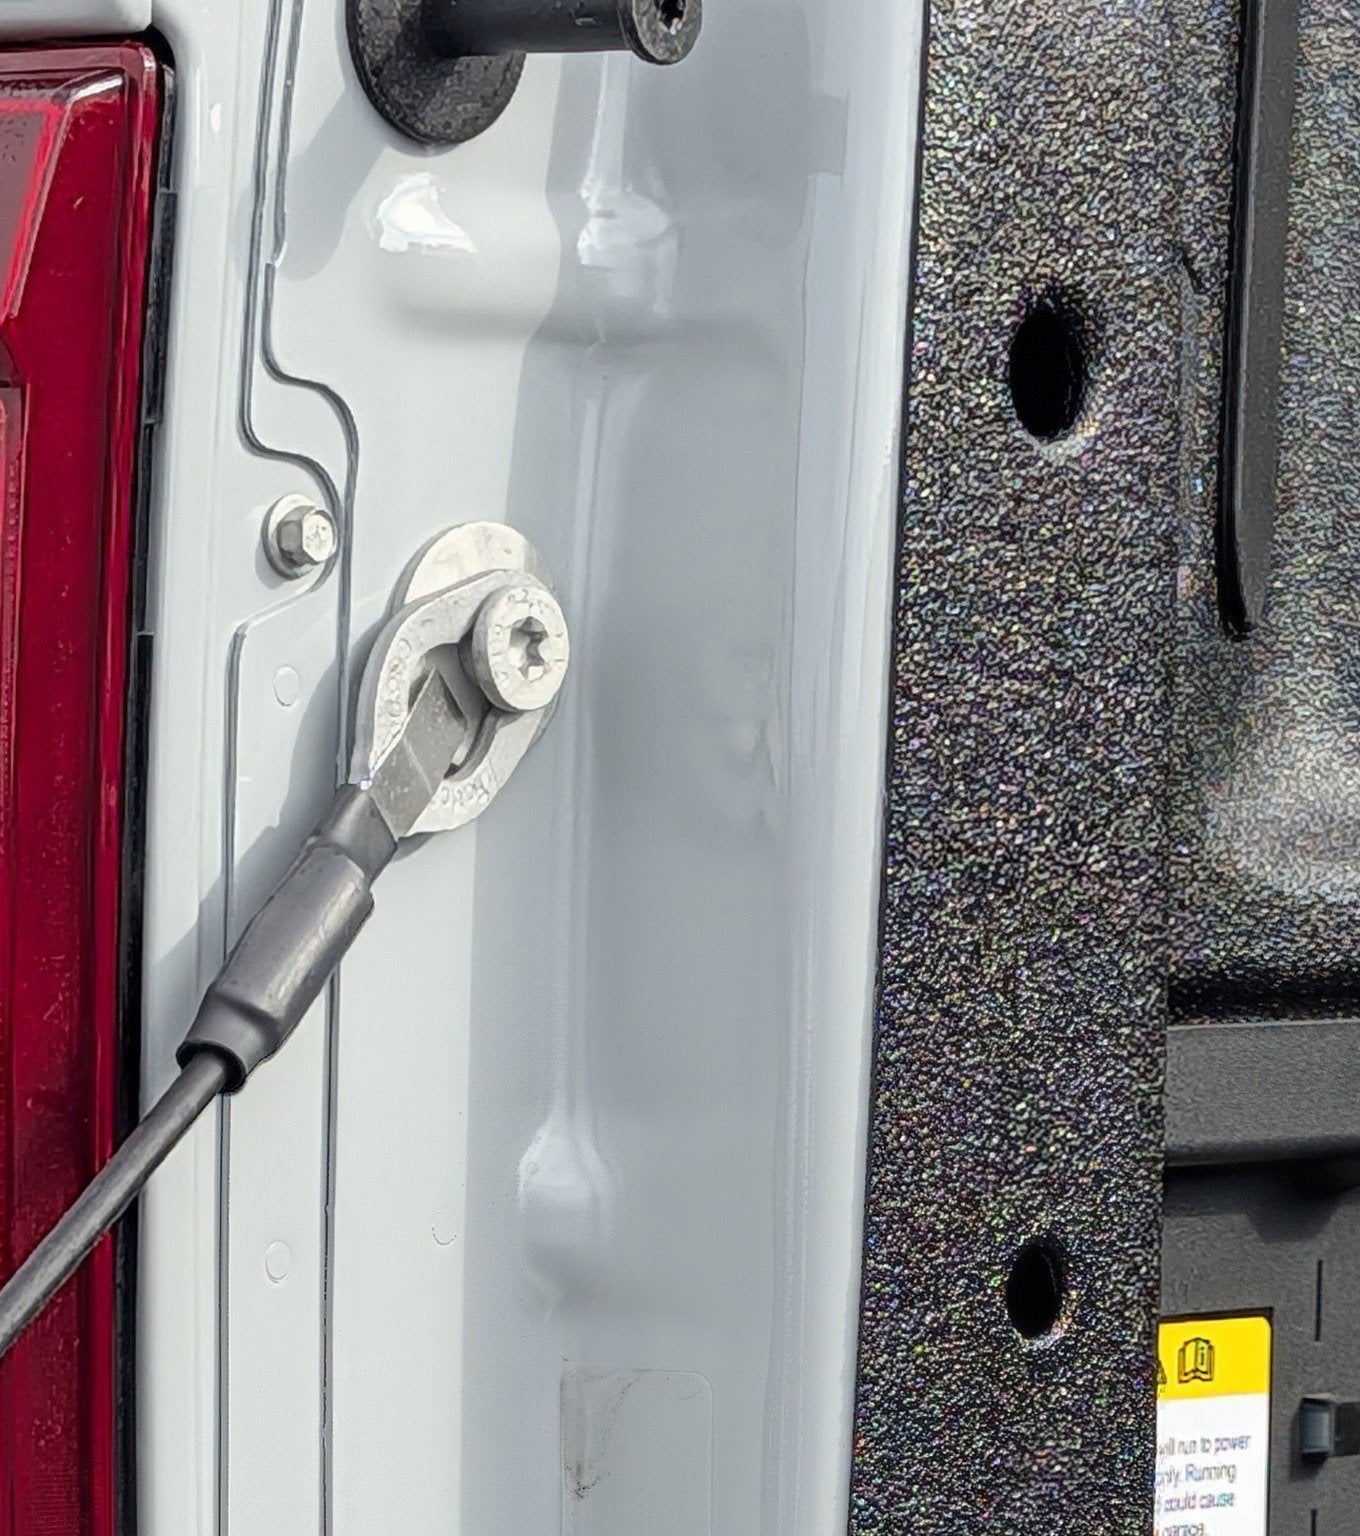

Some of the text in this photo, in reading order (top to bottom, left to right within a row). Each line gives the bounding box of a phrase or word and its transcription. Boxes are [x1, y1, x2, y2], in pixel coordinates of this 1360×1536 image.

[1200, 1437, 1213, 1453] to
[1214, 1435, 1251, 1455] power
[1185, 1463, 1237, 1484] Running
[1164, 1491, 1197, 1512] could
[1200, 1491, 1235, 1509] cause
